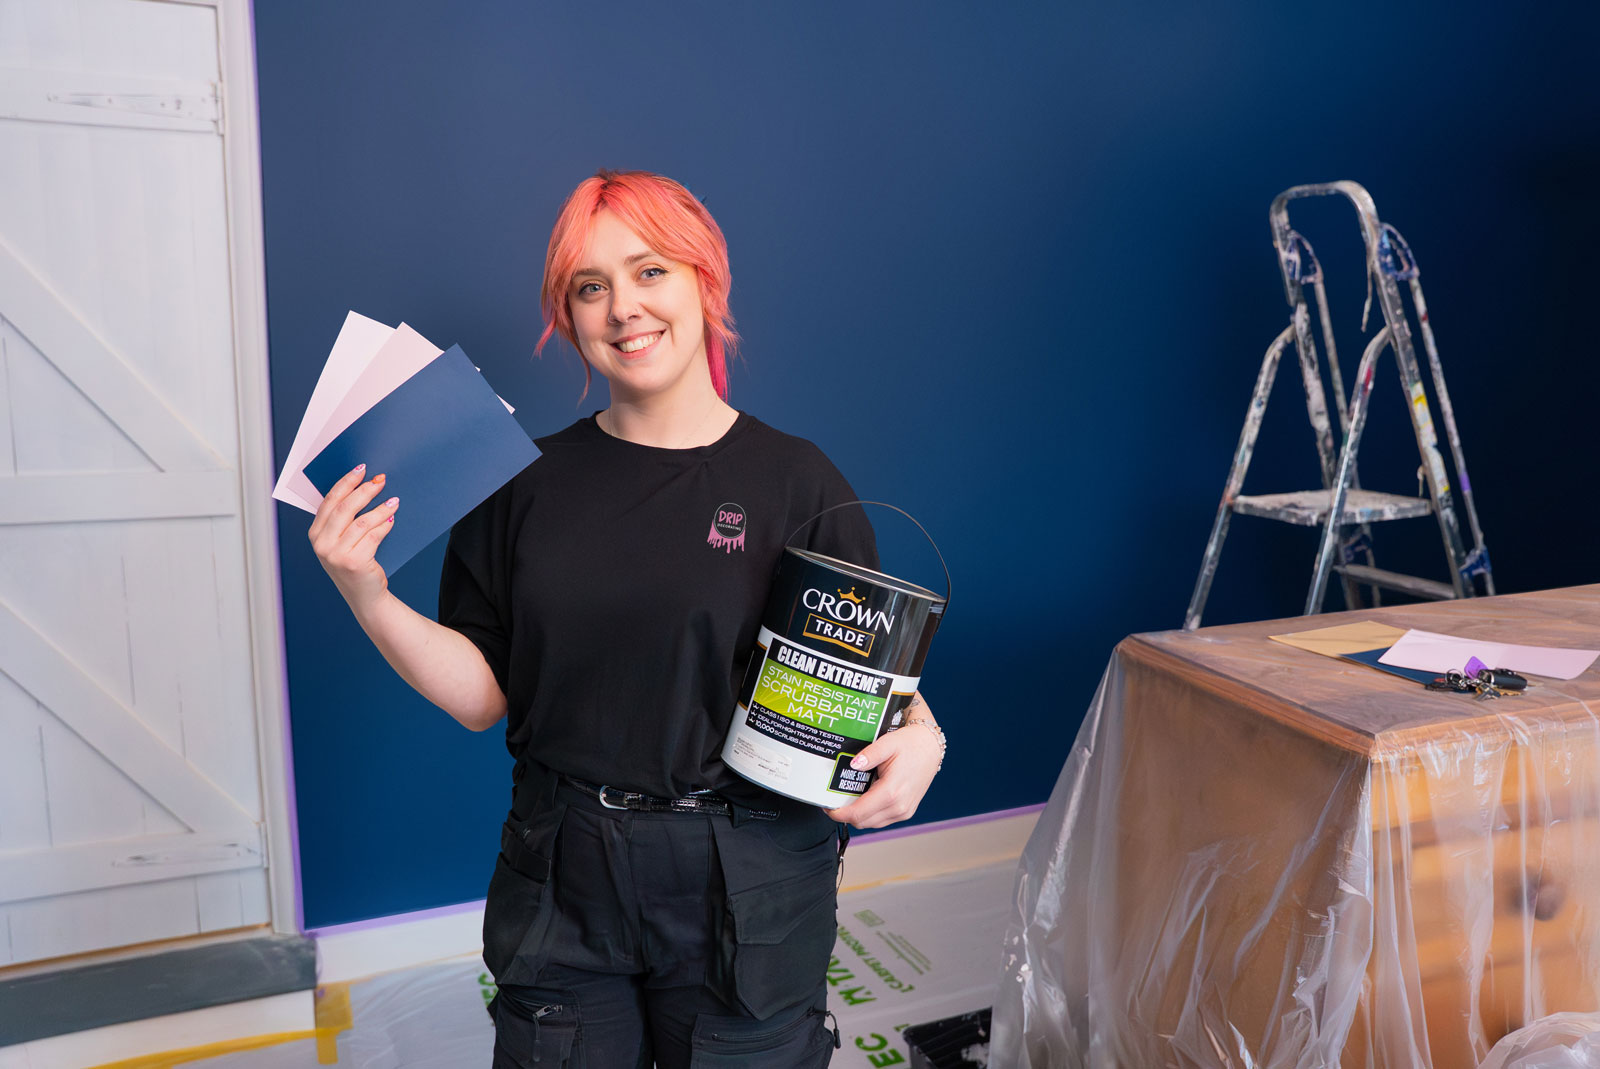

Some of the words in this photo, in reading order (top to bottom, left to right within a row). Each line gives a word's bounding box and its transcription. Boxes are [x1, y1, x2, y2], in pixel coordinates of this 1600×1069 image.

[719, 510, 743, 525] DRIP
[802, 588, 896, 635] CROWN
[815, 619, 866, 647] TRADE
[777, 645, 817, 675] CLEAN
[761, 675, 879, 725] SCRUBBABLE
[768, 665, 802, 687] STAIN
[804, 681, 880, 710] RESISTANT
[760, 707, 777, 719] CLASS
[780, 716, 790, 724] ISO
[819, 731, 845, 742] TESTED
[787, 702, 840, 728] MATT
[755, 720, 775, 733] 10,000
[774, 730, 799, 744] SCRUBS
[799, 740, 836, 755] DURABILITY
[757, 714, 771, 724] IDEAL
[771, 720, 782, 729] FOR
[781, 725, 797, 735] HIGH
[797, 730, 821, 743] TRAFFIC
[820, 739, 842, 749] AREAS
[838, 779, 867, 792] RESISTANT
[840, 768, 857, 780] MORE
